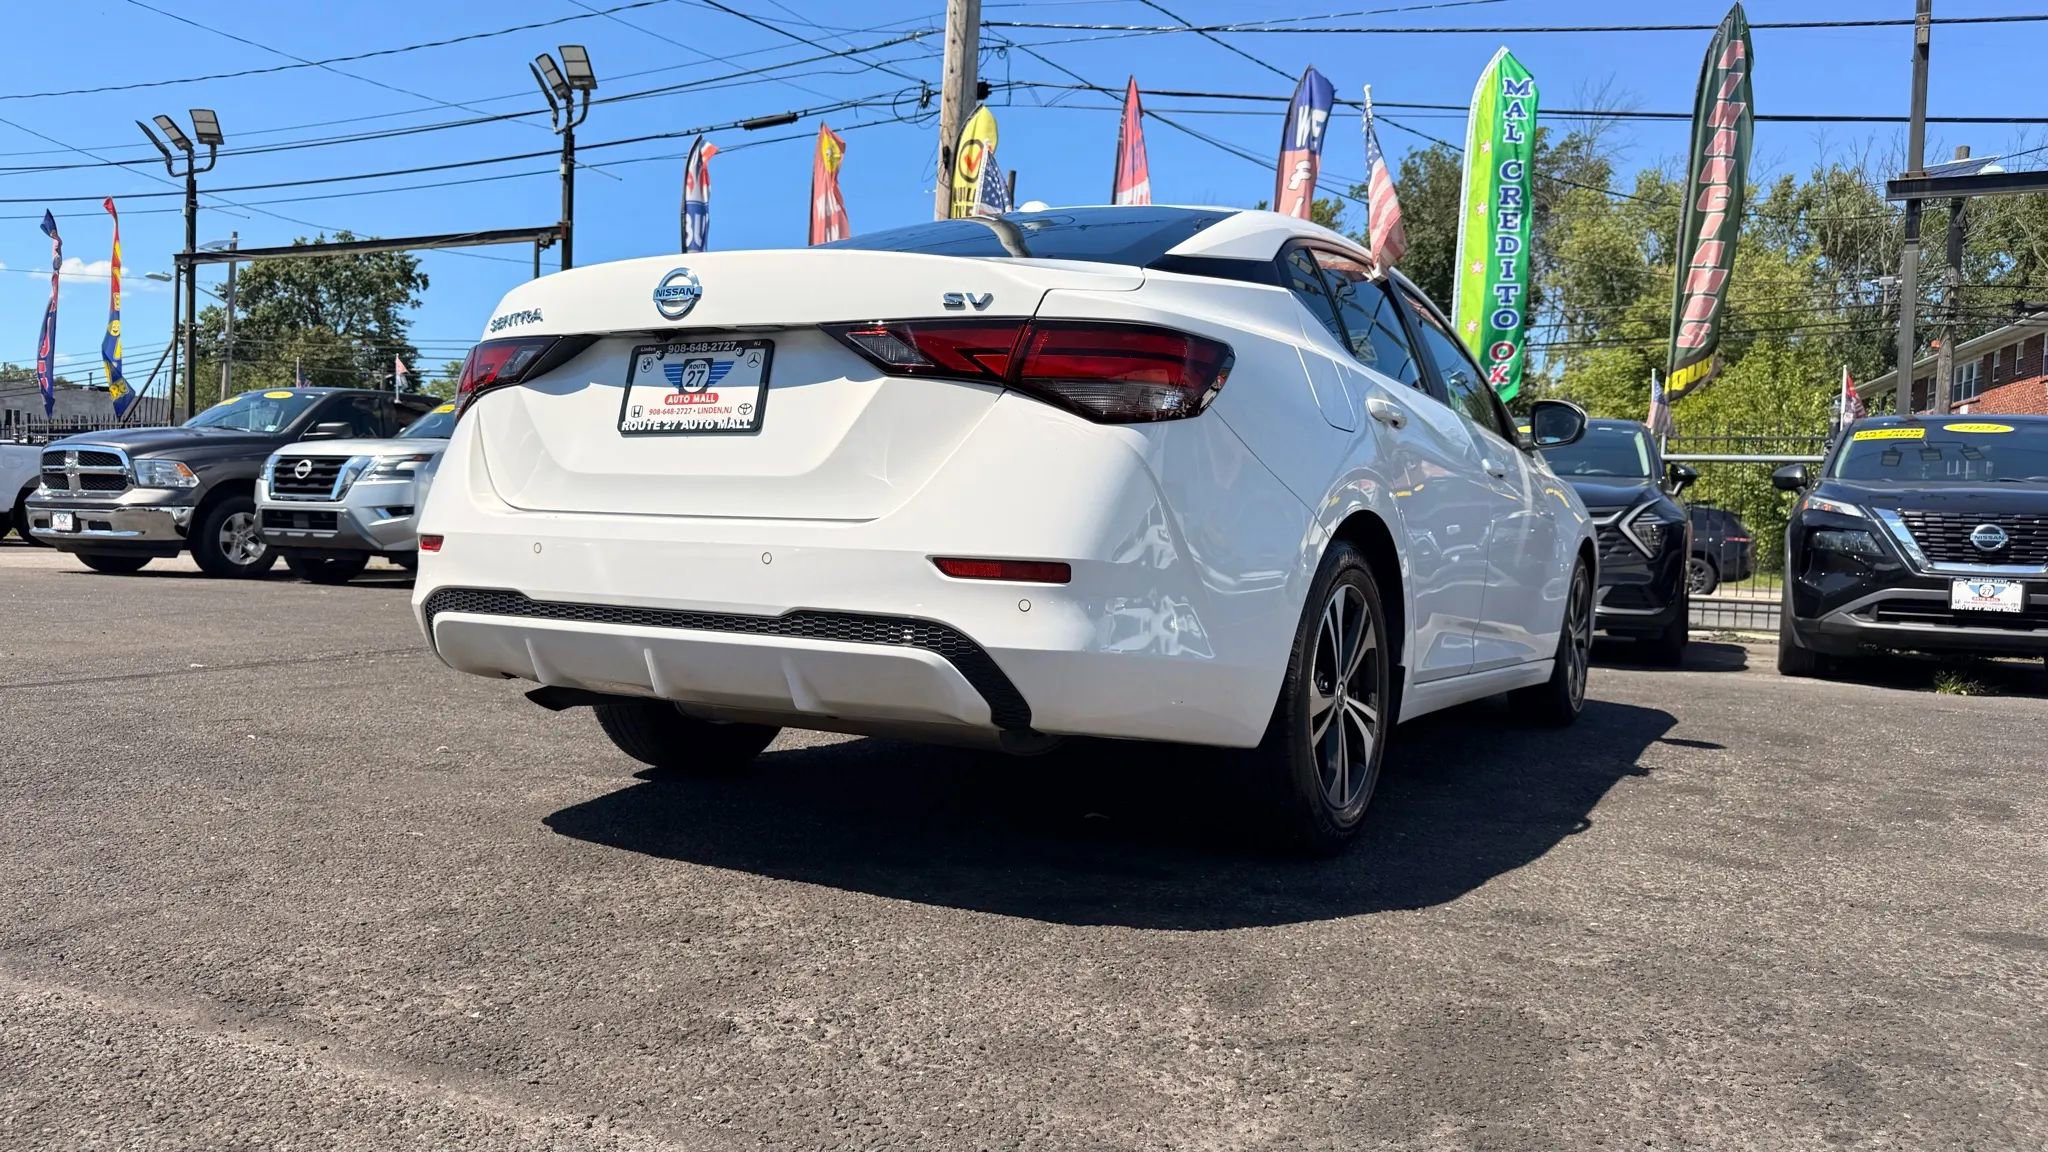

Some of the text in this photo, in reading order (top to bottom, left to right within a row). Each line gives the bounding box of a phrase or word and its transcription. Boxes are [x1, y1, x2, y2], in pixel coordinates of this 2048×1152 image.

[1489, 78, 1532, 385] MAL CREDITO OK
[655, 287, 695, 297] NISSAN
[943, 292, 994, 311] SV
[490, 308, 543, 332] SENTRA
[668, 341, 737, 354] 908-648-2727
[686, 370, 705, 387] 27
[666, 394, 715, 403] AUTO MALL
[648, 407, 692, 415] 908-648-2727
[621, 419, 751, 431] ROUTE 27 AUTO MALL
